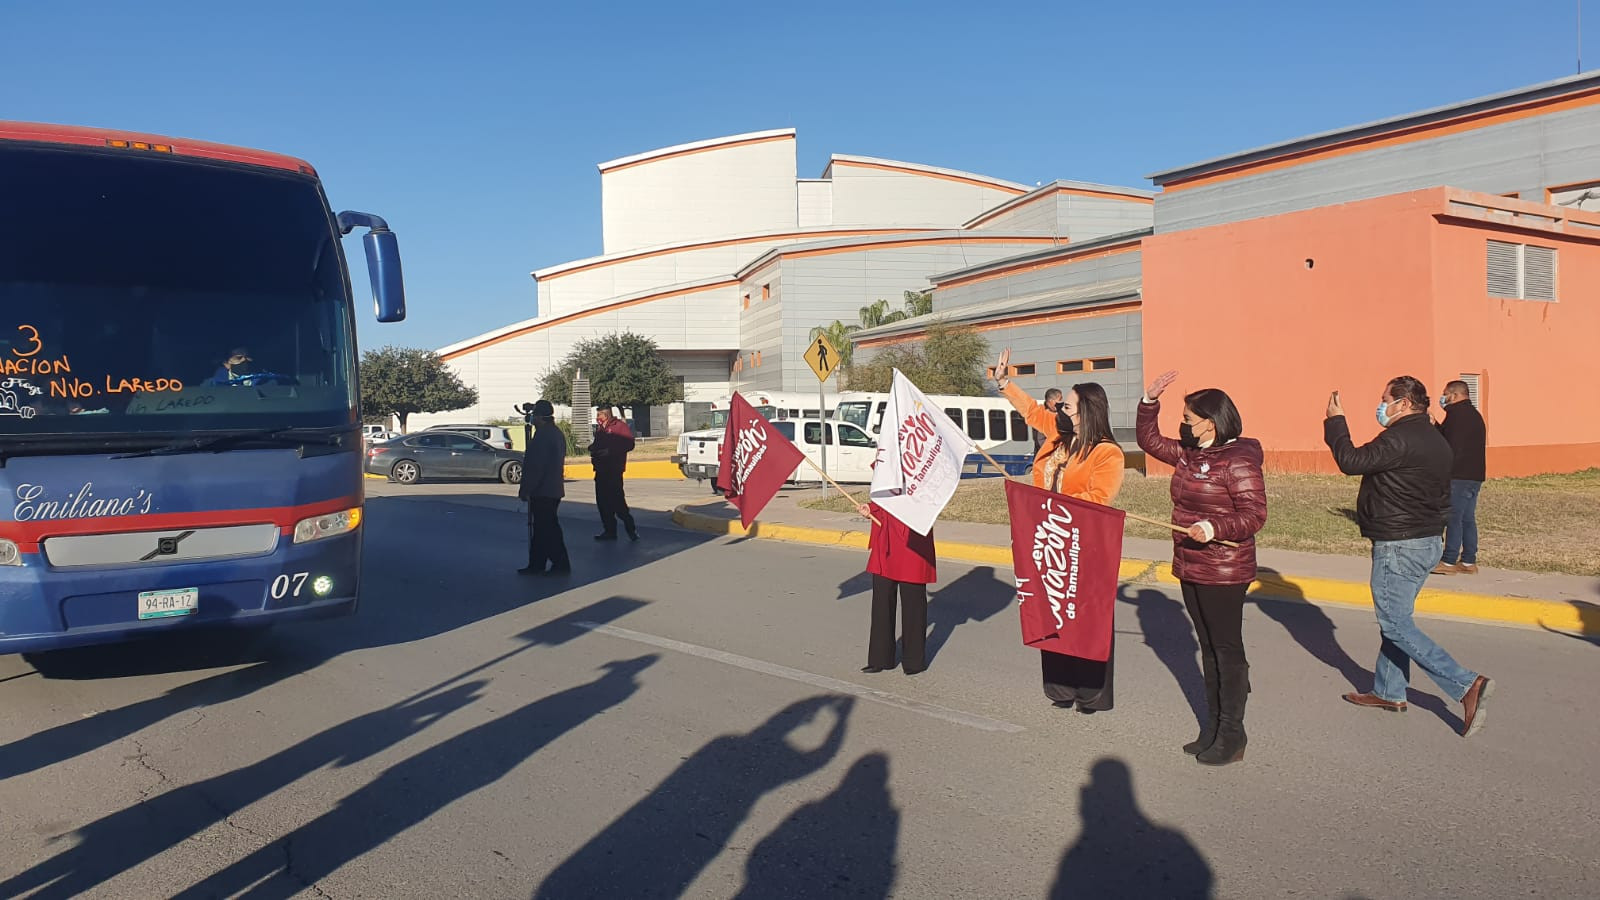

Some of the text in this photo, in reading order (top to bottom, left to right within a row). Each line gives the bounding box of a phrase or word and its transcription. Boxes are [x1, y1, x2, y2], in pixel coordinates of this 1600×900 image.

[12, 324, 42, 357] 3
[105, 374, 183, 394] LAREDO
[906, 435, 943, 496] de Tamaulipas
[14, 481, 152, 522] Emiliano's
[271, 571, 310, 600] 07
[1065, 527, 1081, 619] de Tamaulipas
